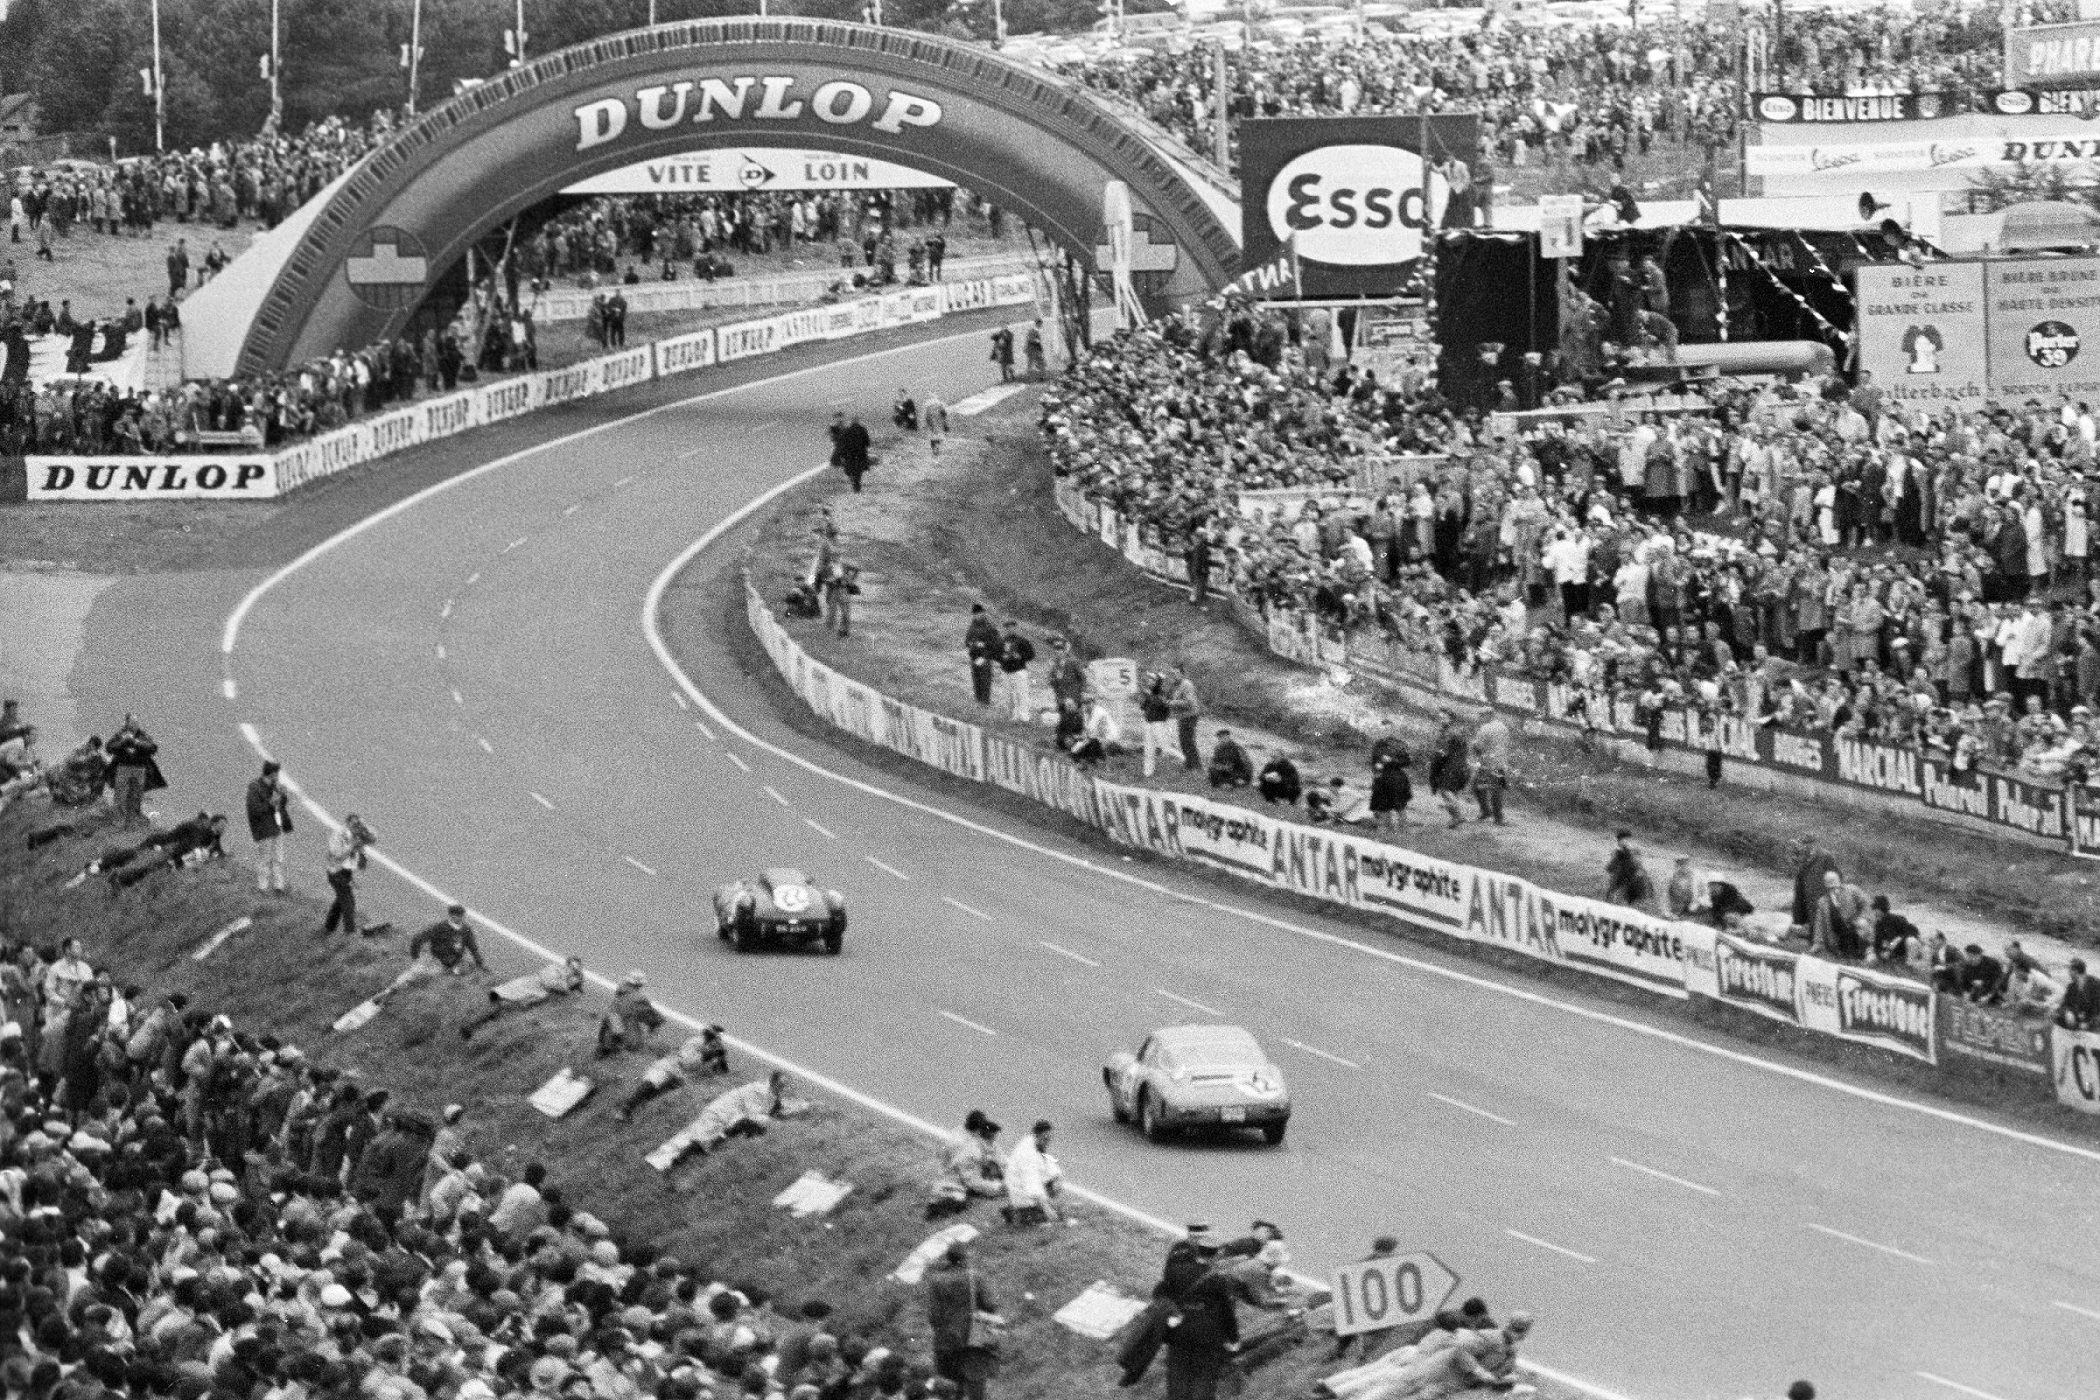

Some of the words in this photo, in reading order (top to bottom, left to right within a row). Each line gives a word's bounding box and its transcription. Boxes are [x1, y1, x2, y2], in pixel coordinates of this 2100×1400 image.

[575, 76, 942, 151] DUNLOP
[1803, 97, 1904, 121] BIENVENUE
[648, 165, 711, 183] VITE
[804, 162, 869, 181] LOIN
[1286, 173, 1425, 230] Esso
[42, 464, 265, 490] DUNLOP
[1272, 827, 1359, 901] ANTAR
[1361, 853, 1460, 903] molygraphite
[1467, 874, 1563, 959] ANTAR
[1559, 906, 1684, 961] molygraphite
[1340, 1262, 1424, 1325] 100
